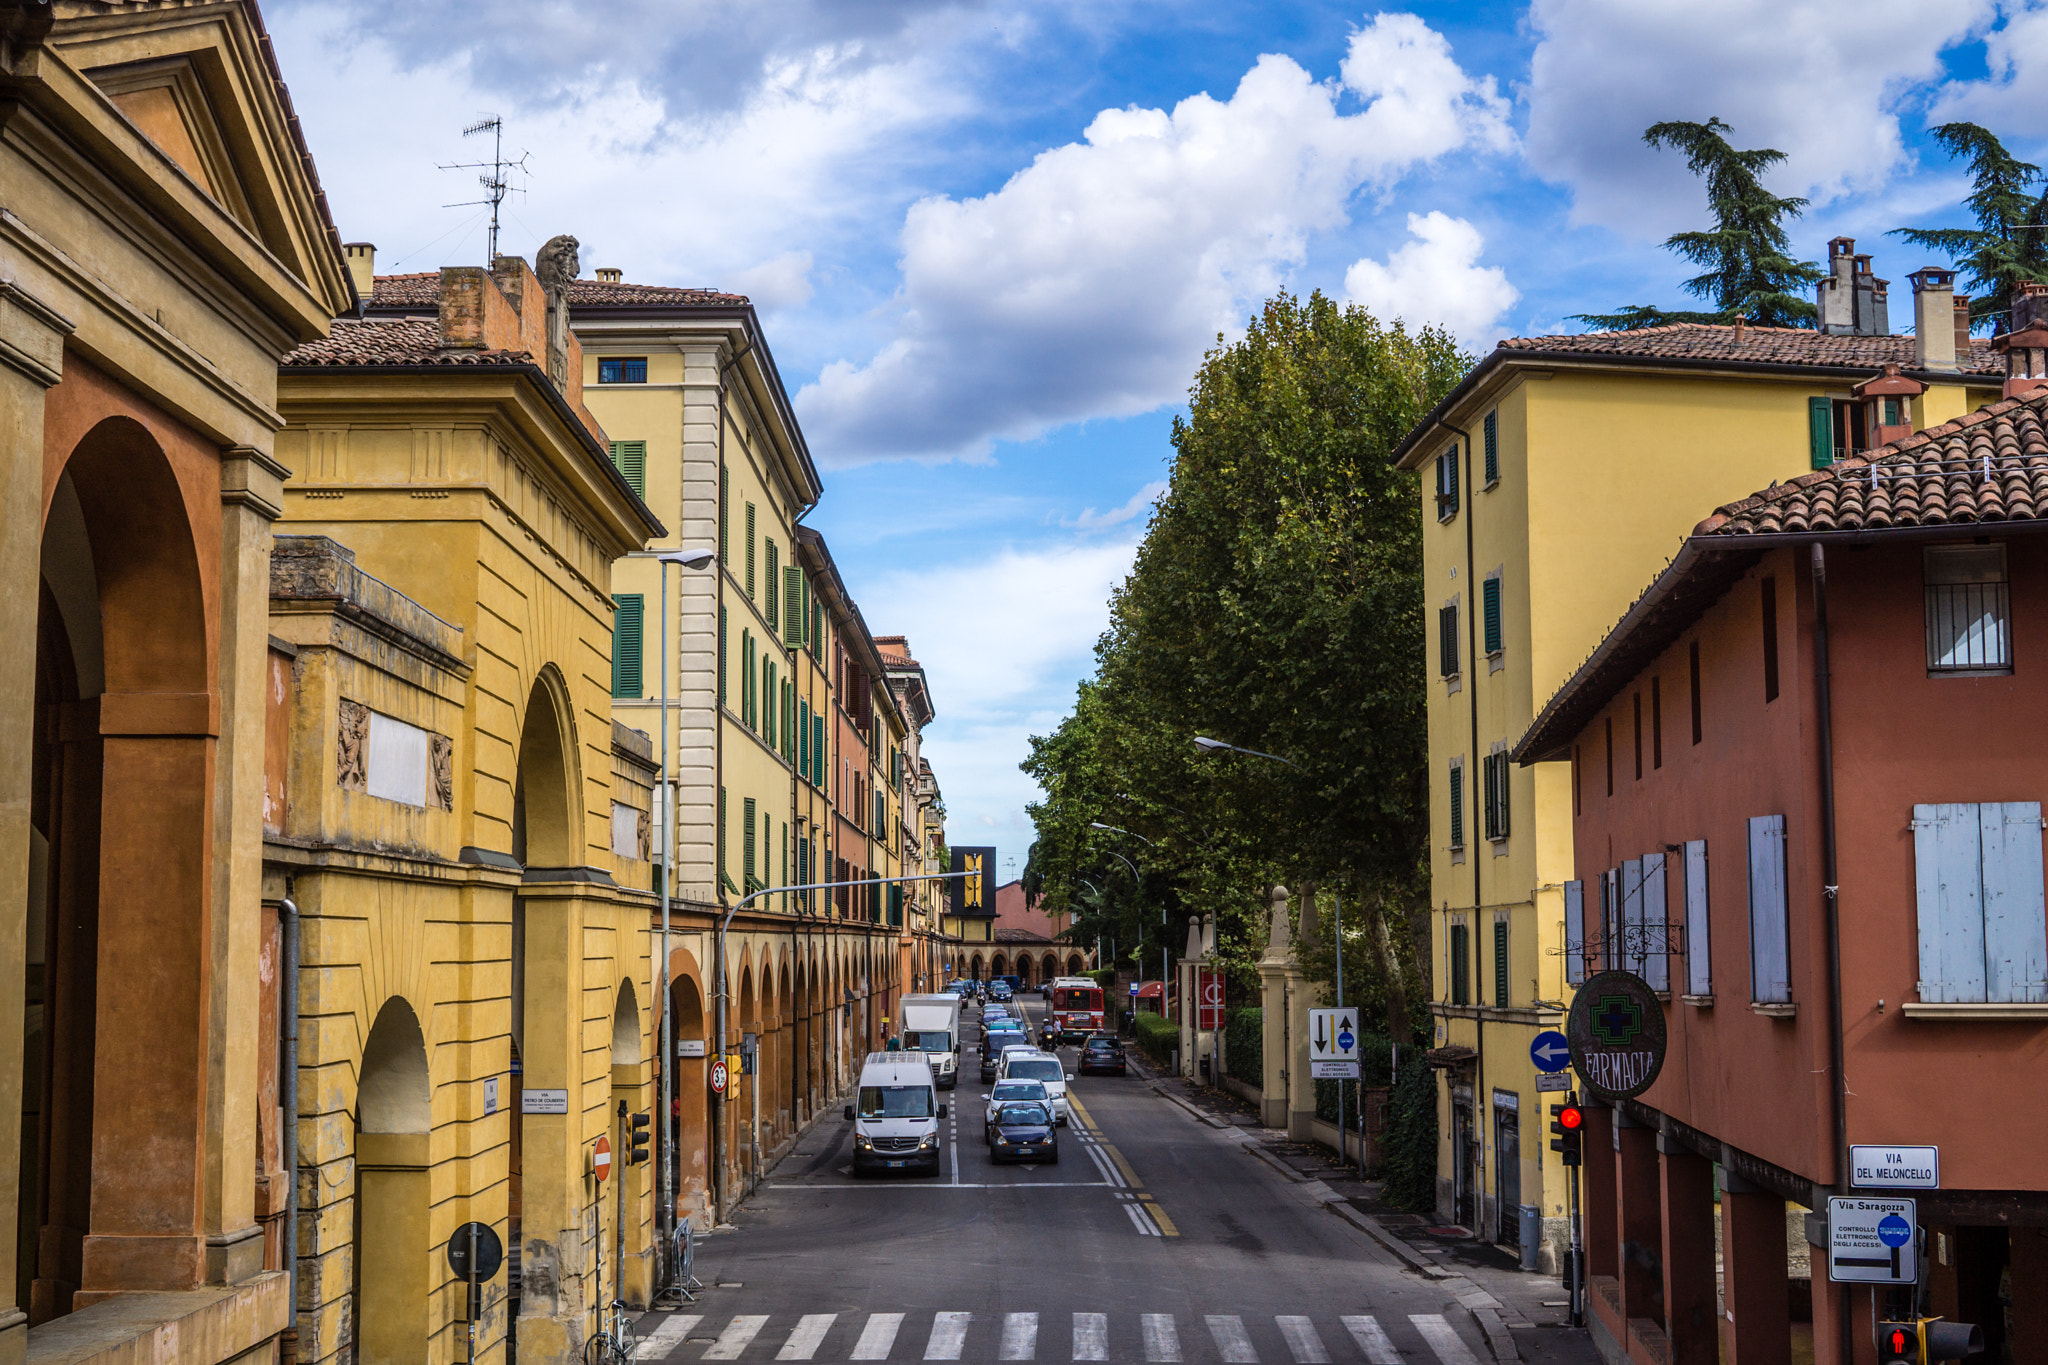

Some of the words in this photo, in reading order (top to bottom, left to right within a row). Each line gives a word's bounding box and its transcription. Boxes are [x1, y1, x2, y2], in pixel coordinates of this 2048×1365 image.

[715, 1069, 720, 1083] 3
[1585, 1051, 1653, 1092] FARMACIA
[1886, 1153, 1902, 1164] VIA
[1857, 1168, 1873, 1178] DEL
[1876, 1168, 1932, 1180] MELONCELLO
[1838, 1201, 1854, 1210] Via
[1857, 1201, 1905, 1213] Saragozza
